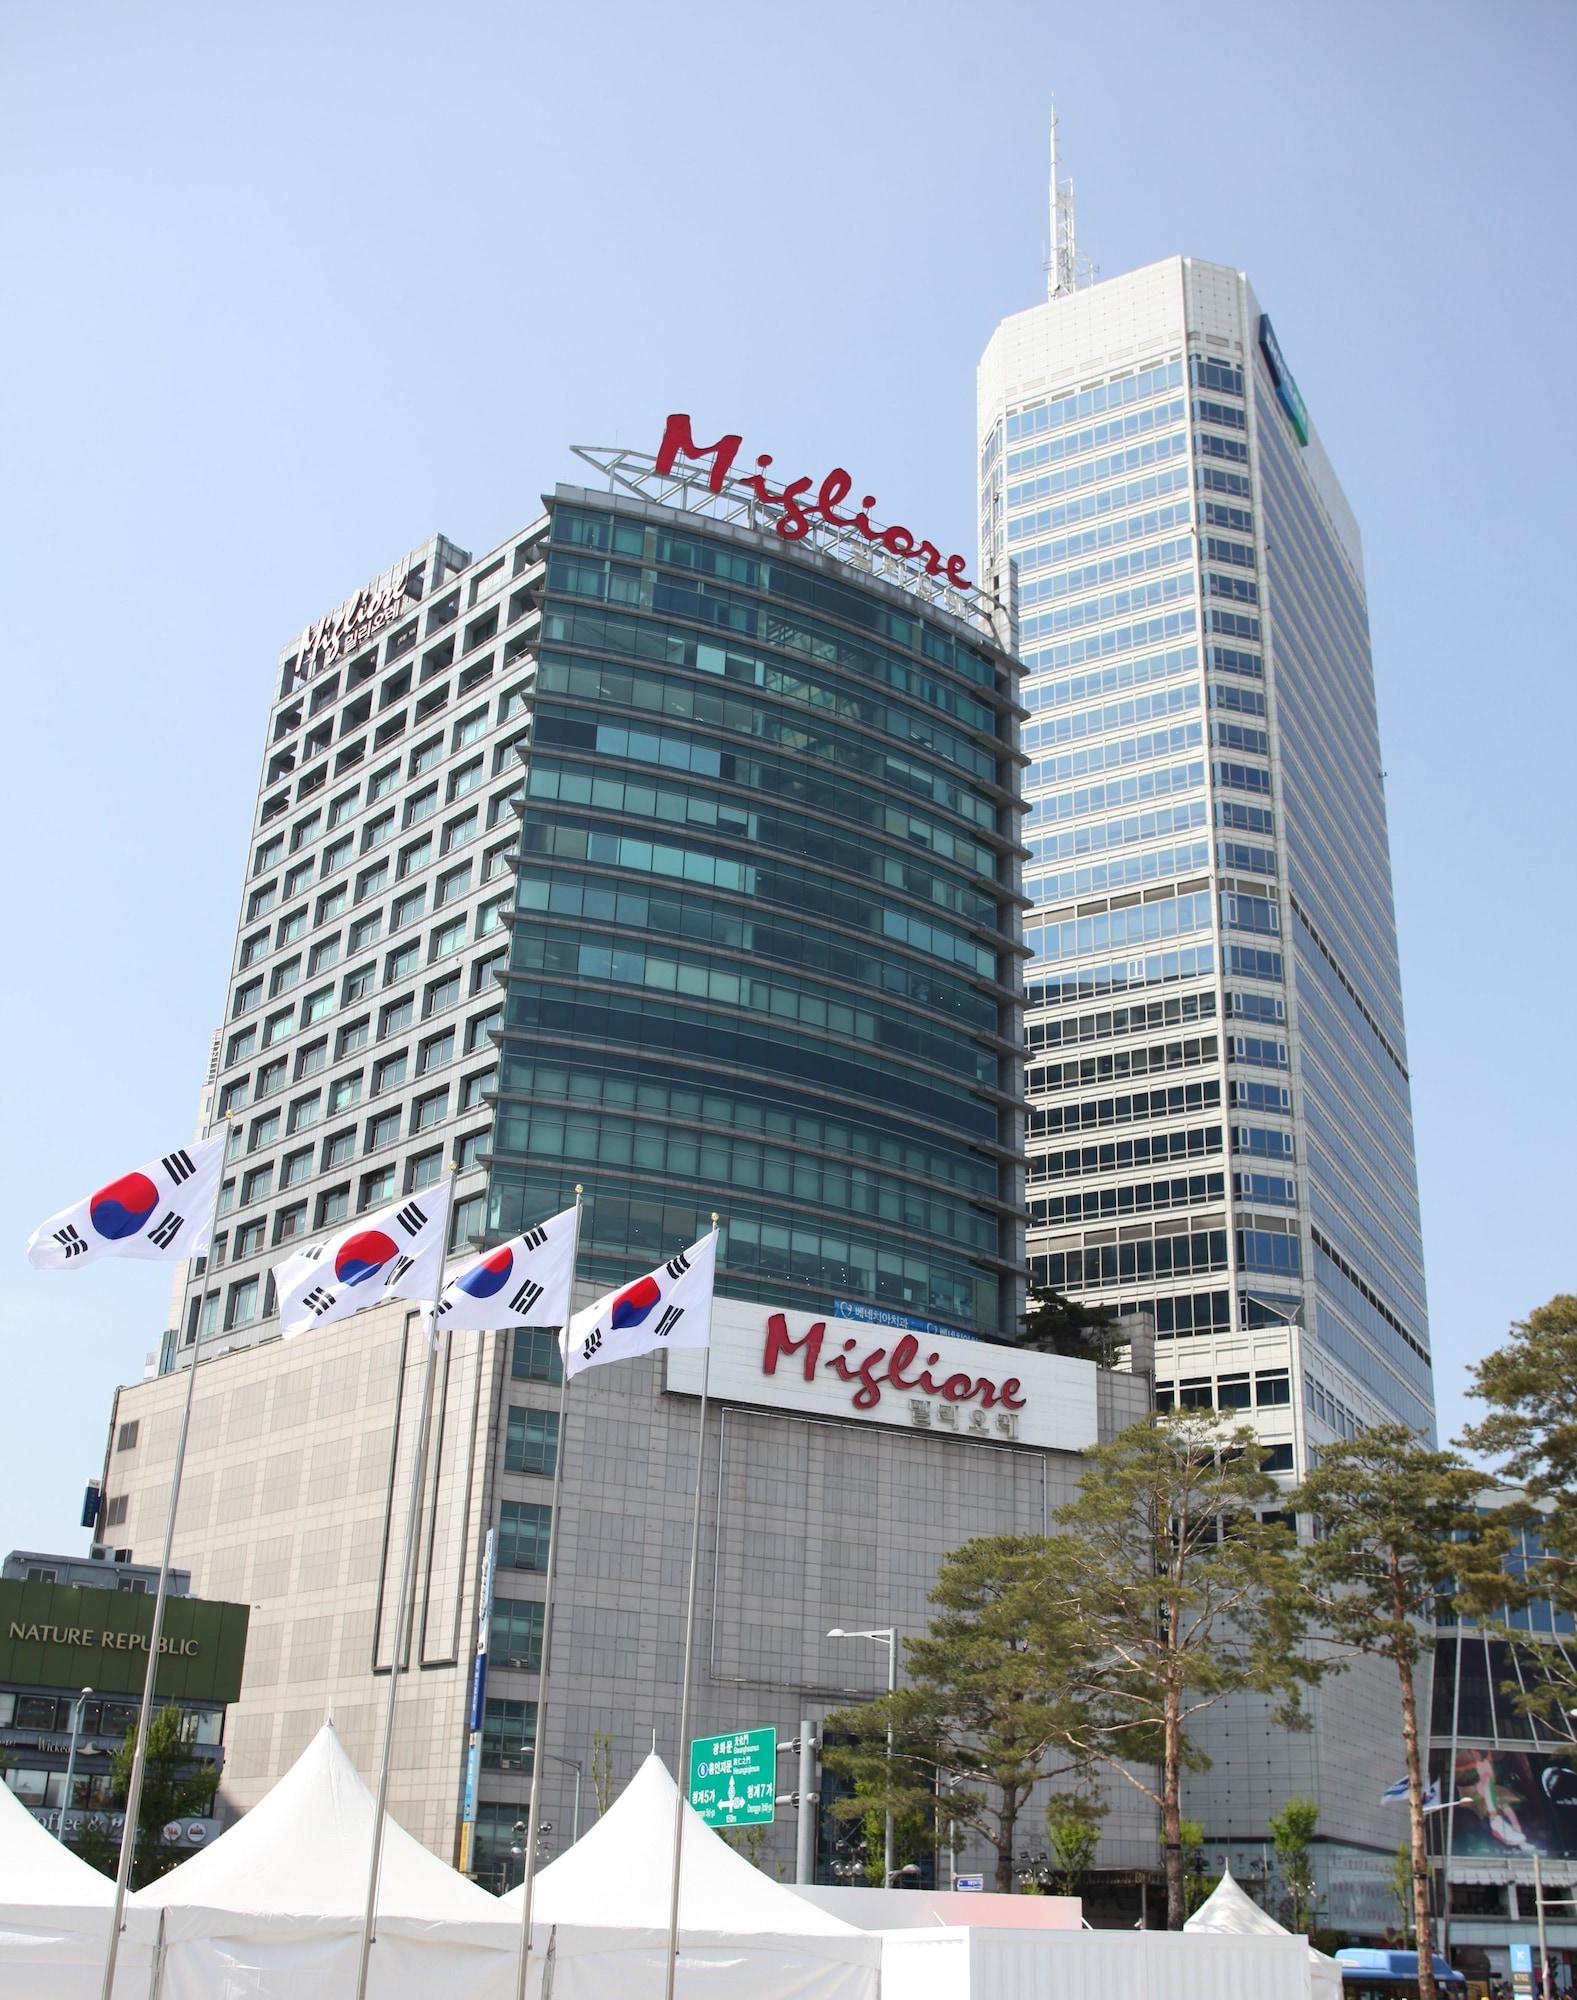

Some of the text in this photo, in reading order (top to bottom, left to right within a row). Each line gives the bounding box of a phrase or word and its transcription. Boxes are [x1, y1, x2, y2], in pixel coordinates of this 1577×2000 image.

[656, 414, 972, 589] Migliore
[295, 573, 408, 673] Migliore
[344, 599, 401, 654] 밀리오레
[854, 1306, 909, 1329] 베네치아치과
[762, 1313, 1028, 1409] Migliore
[9, 1621, 199, 1656] NATURE REPUBLIC
[30, 1811, 81, 1831] offee
